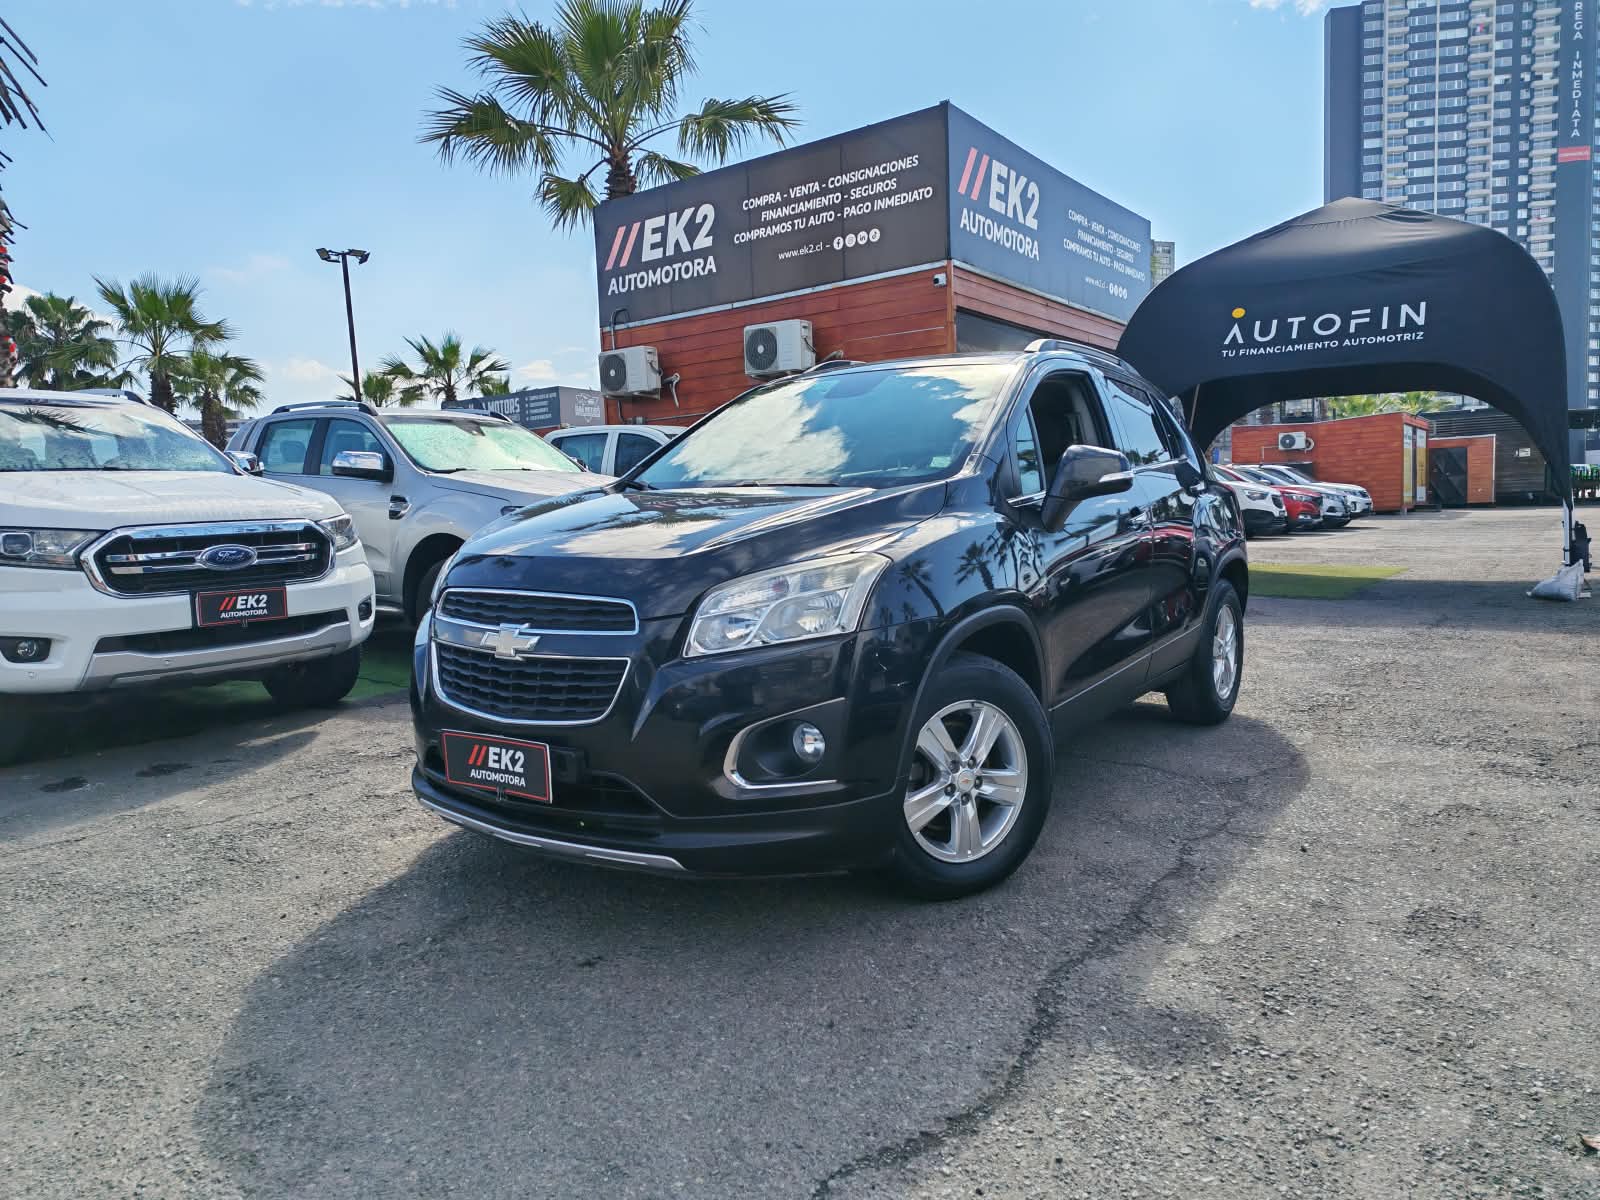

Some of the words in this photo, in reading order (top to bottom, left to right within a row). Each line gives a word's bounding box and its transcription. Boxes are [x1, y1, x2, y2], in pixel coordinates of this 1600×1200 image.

[1571, 50, 1583, 137] INMEDIATA
[742, 192, 782, 210] COMPRA
[789, 181, 820, 199] VENTA
[828, 155, 919, 189] CONSIGNACIONES
[761, 192, 841, 222] FINANCIAMIENTO
[850, 178, 897, 200] SEGUROS
[733, 221, 792, 244] COMPRAMOS
[794, 217, 806, 230] TU
[808, 211, 835, 227] AUTO
[843, 202, 872, 218] PAGO
[874, 187, 933, 211] INMEDIATO
[959, 207, 1040, 261] AUTOMOTORA
[778, 242, 823, 260] www.ek2.cl
[607, 255, 717, 296] AUTOMOTORA
[1223, 301, 1427, 345] AUTOFIN
[1221, 349, 1236, 358] TU
[1239, 340, 1339, 356] FINANCIAMIENTO
[1342, 331, 1425, 347] AUTOMOTRIZ
[487, 398, 520, 415] MOTORS
[220, 609, 268, 618] AUTOMOTORA
[470, 769, 526, 787] AUTOMOTORA
